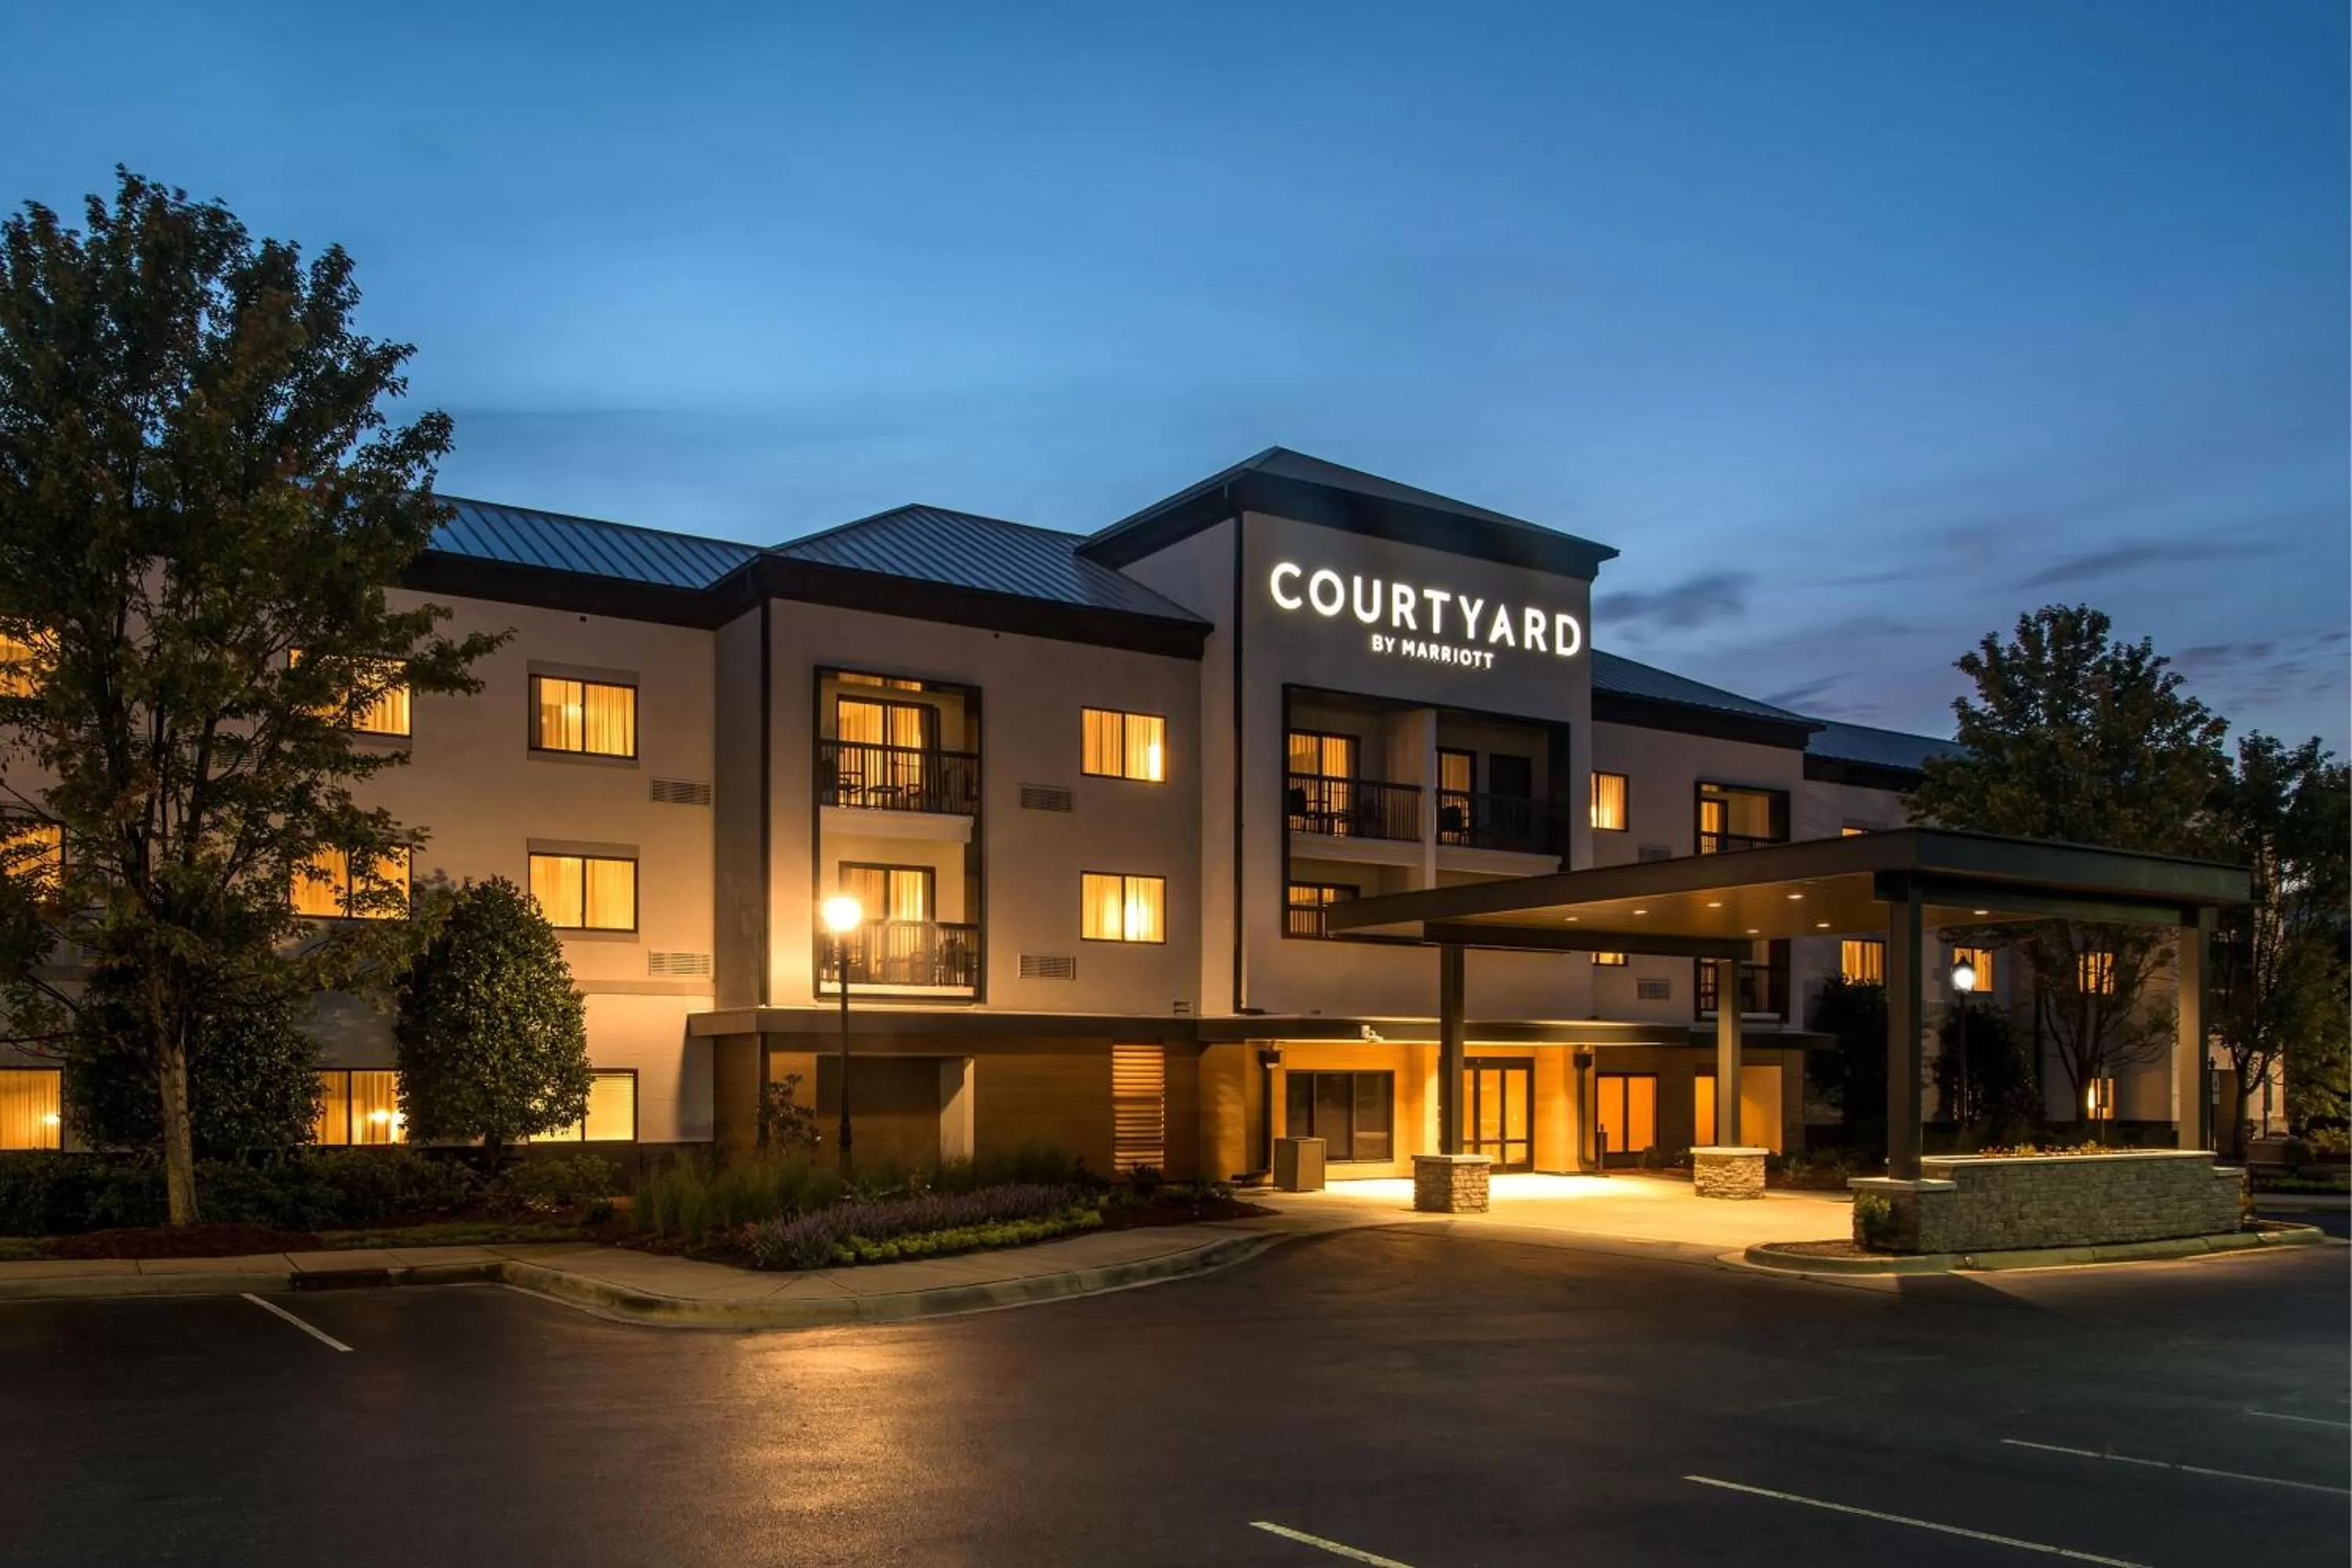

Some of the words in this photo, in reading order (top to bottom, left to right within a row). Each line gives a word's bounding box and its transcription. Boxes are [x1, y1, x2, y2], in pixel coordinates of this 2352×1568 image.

[1269, 561, 1582, 657] COURTYARD
[1371, 633, 1396, 653] BY
[1401, 638, 1494, 670] MARRIOTT
